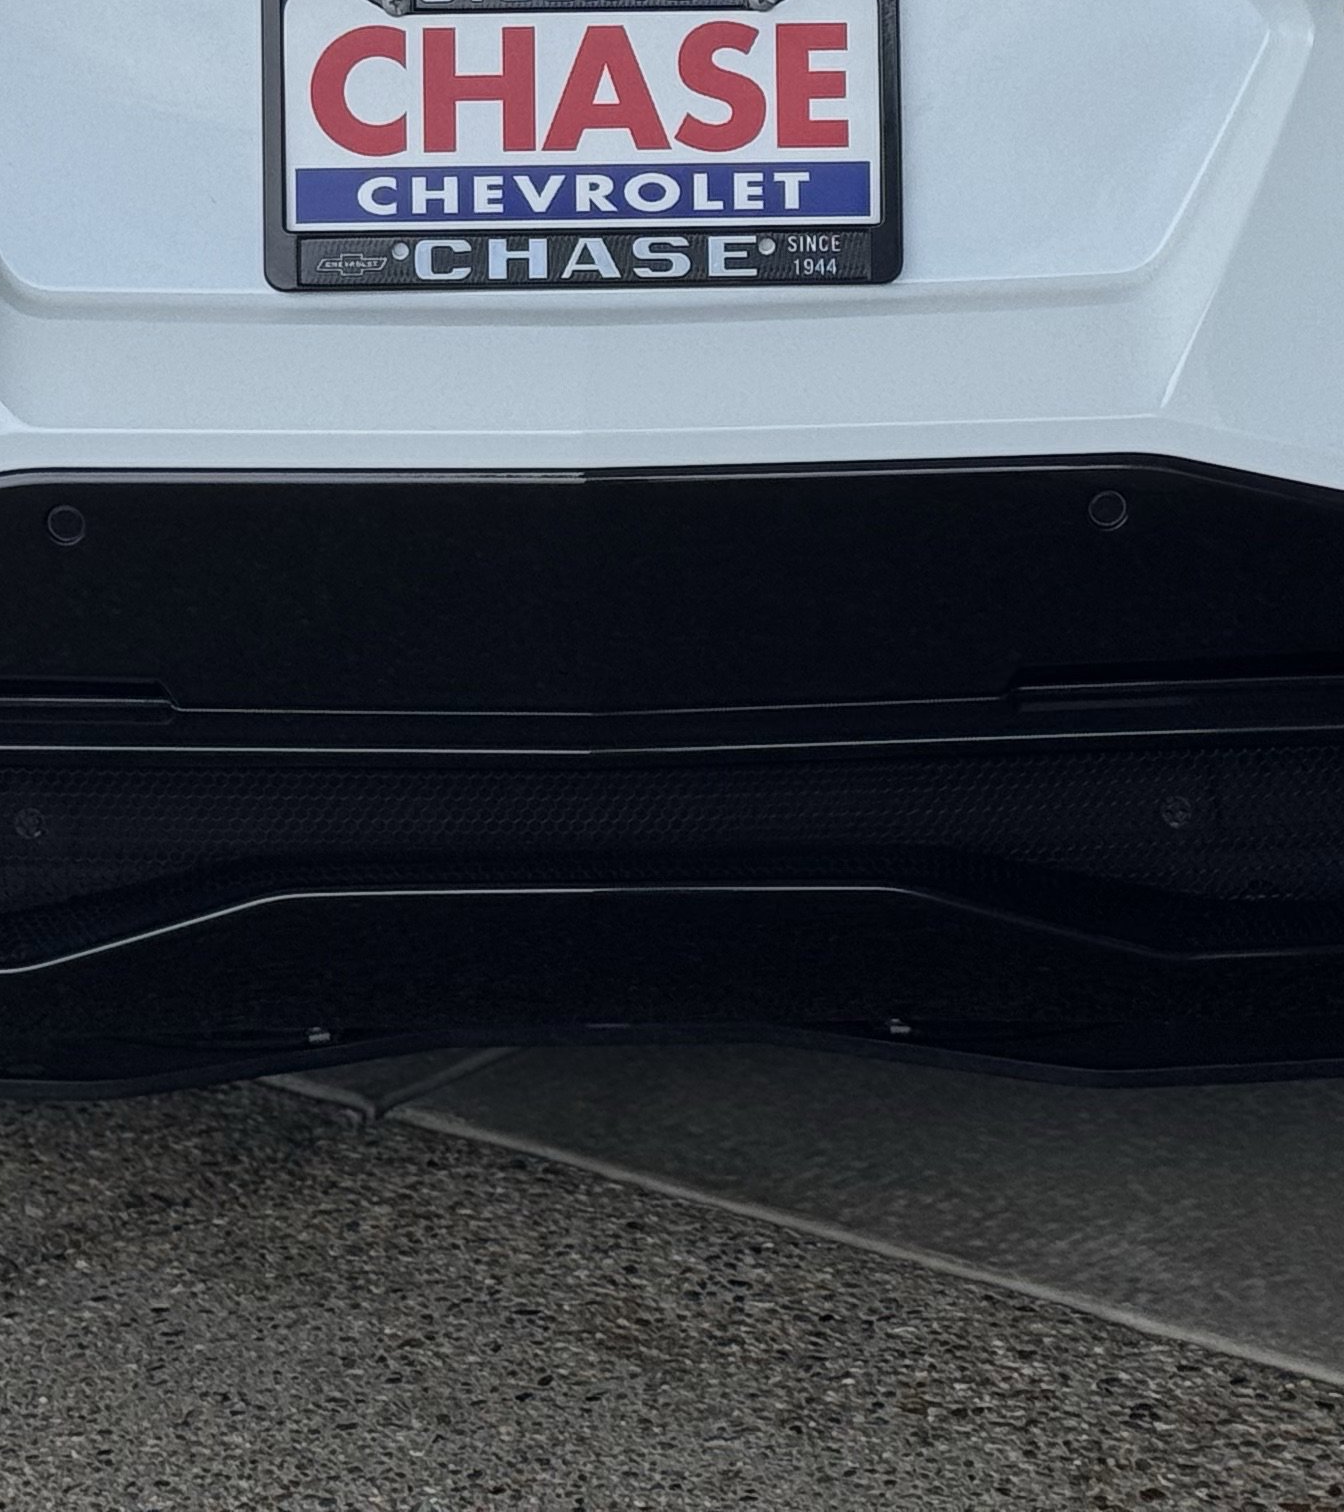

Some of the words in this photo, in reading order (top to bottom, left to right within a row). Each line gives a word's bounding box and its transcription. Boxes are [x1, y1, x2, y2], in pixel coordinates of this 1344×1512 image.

[310, 20, 850, 157] CHASE
[356, 171, 811, 215] CHEVROLET
[414, 234, 758, 281] CHASE
[787, 234, 841, 252] SINCE
[793, 258, 837, 276] 1944
